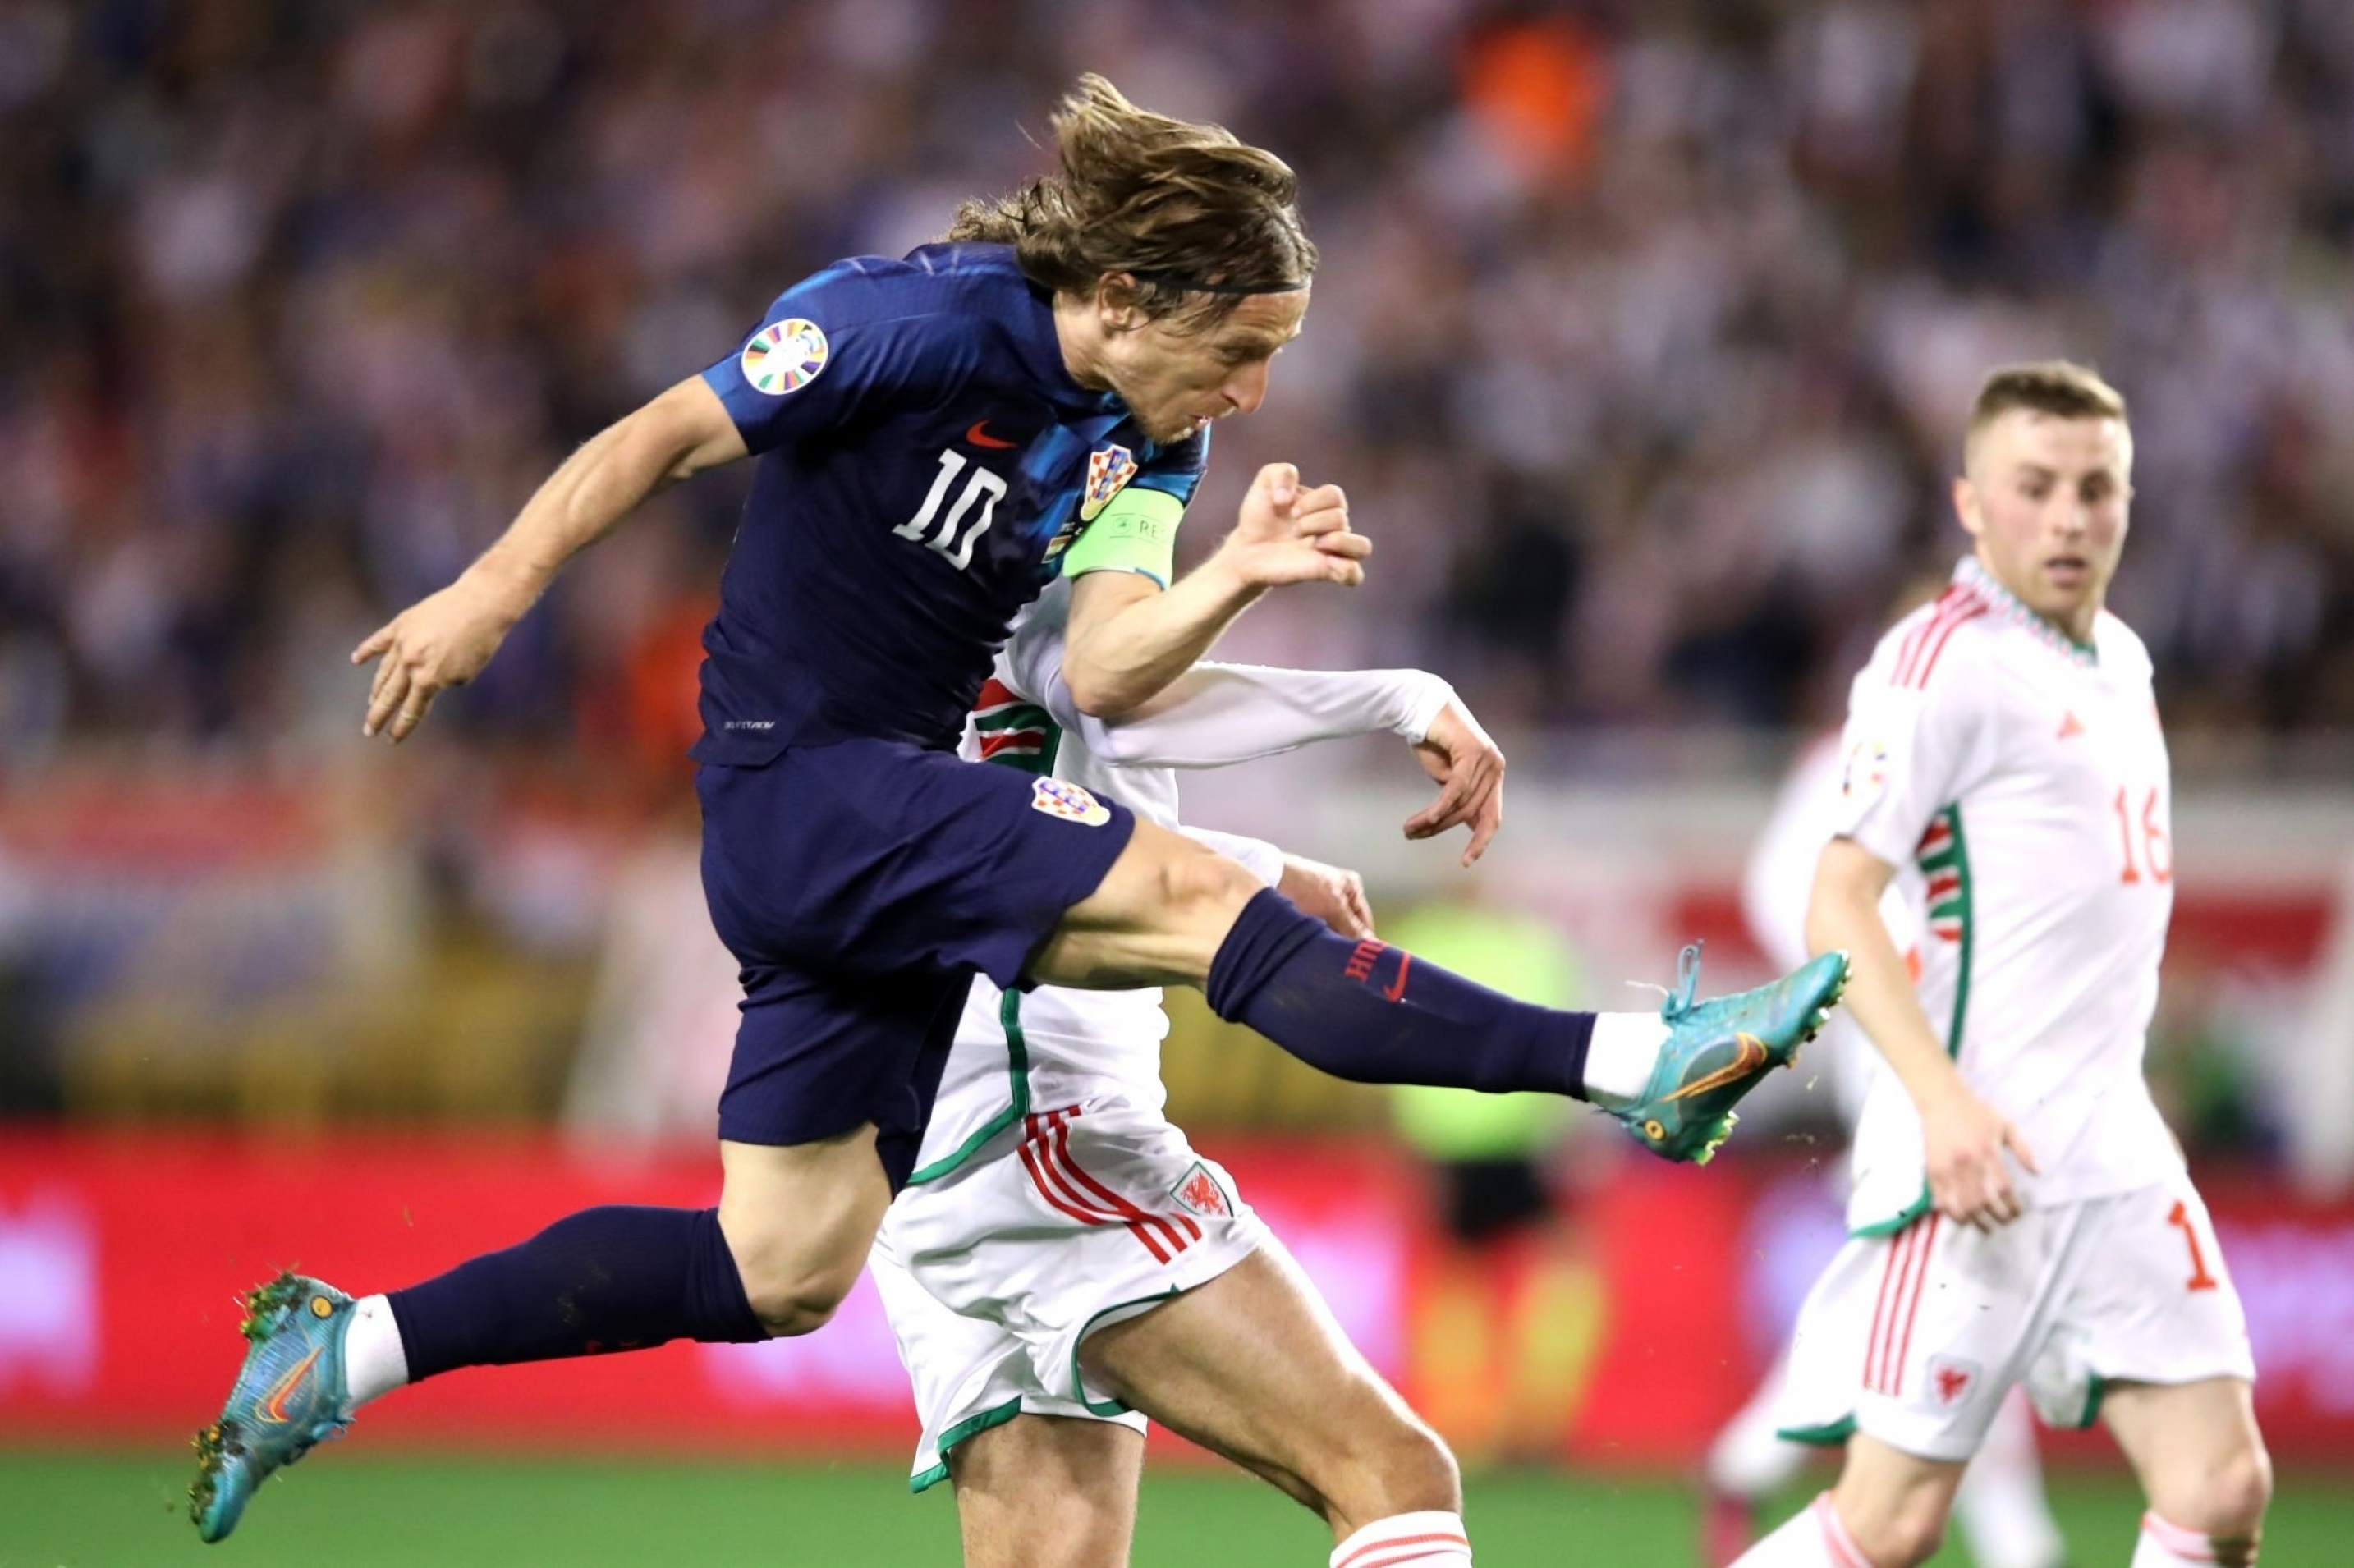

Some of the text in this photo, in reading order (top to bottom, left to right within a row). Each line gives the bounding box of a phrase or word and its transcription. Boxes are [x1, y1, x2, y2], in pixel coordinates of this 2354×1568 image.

[893, 448, 1007, 571] 10
[1140, 520, 1166, 540] RE
[2115, 786, 2173, 884] 16
[2168, 1201, 2217, 1292] 1
